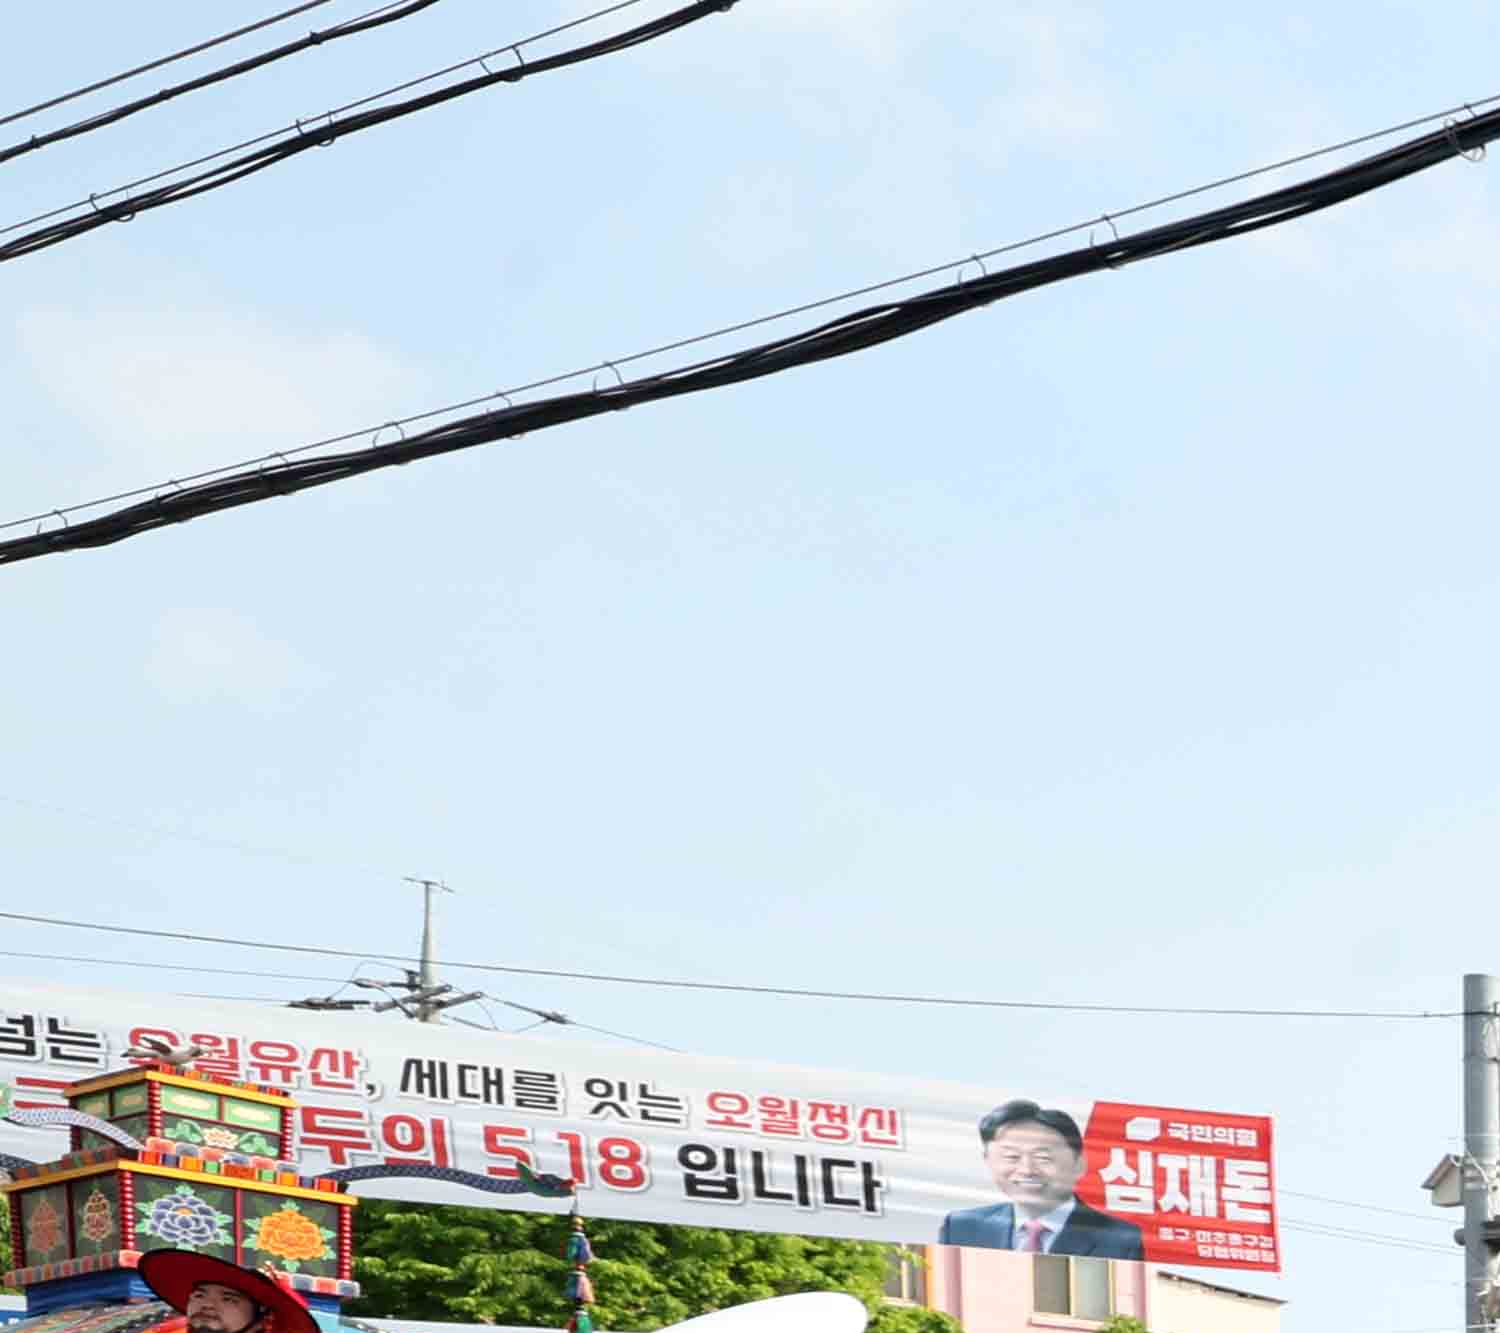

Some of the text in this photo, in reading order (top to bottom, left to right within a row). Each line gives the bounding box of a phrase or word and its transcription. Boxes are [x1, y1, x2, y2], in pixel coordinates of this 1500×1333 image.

[401, 1058, 559, 1111] 세대를
[585, 1077, 683, 1125] 잇는
[706, 1090, 898, 1145] 오월정신
[1167, 1122, 1257, 1147] 국민의힘
[678, 1143, 884, 1212] 입니다
[1099, 1147, 1272, 1224] 심재돈
